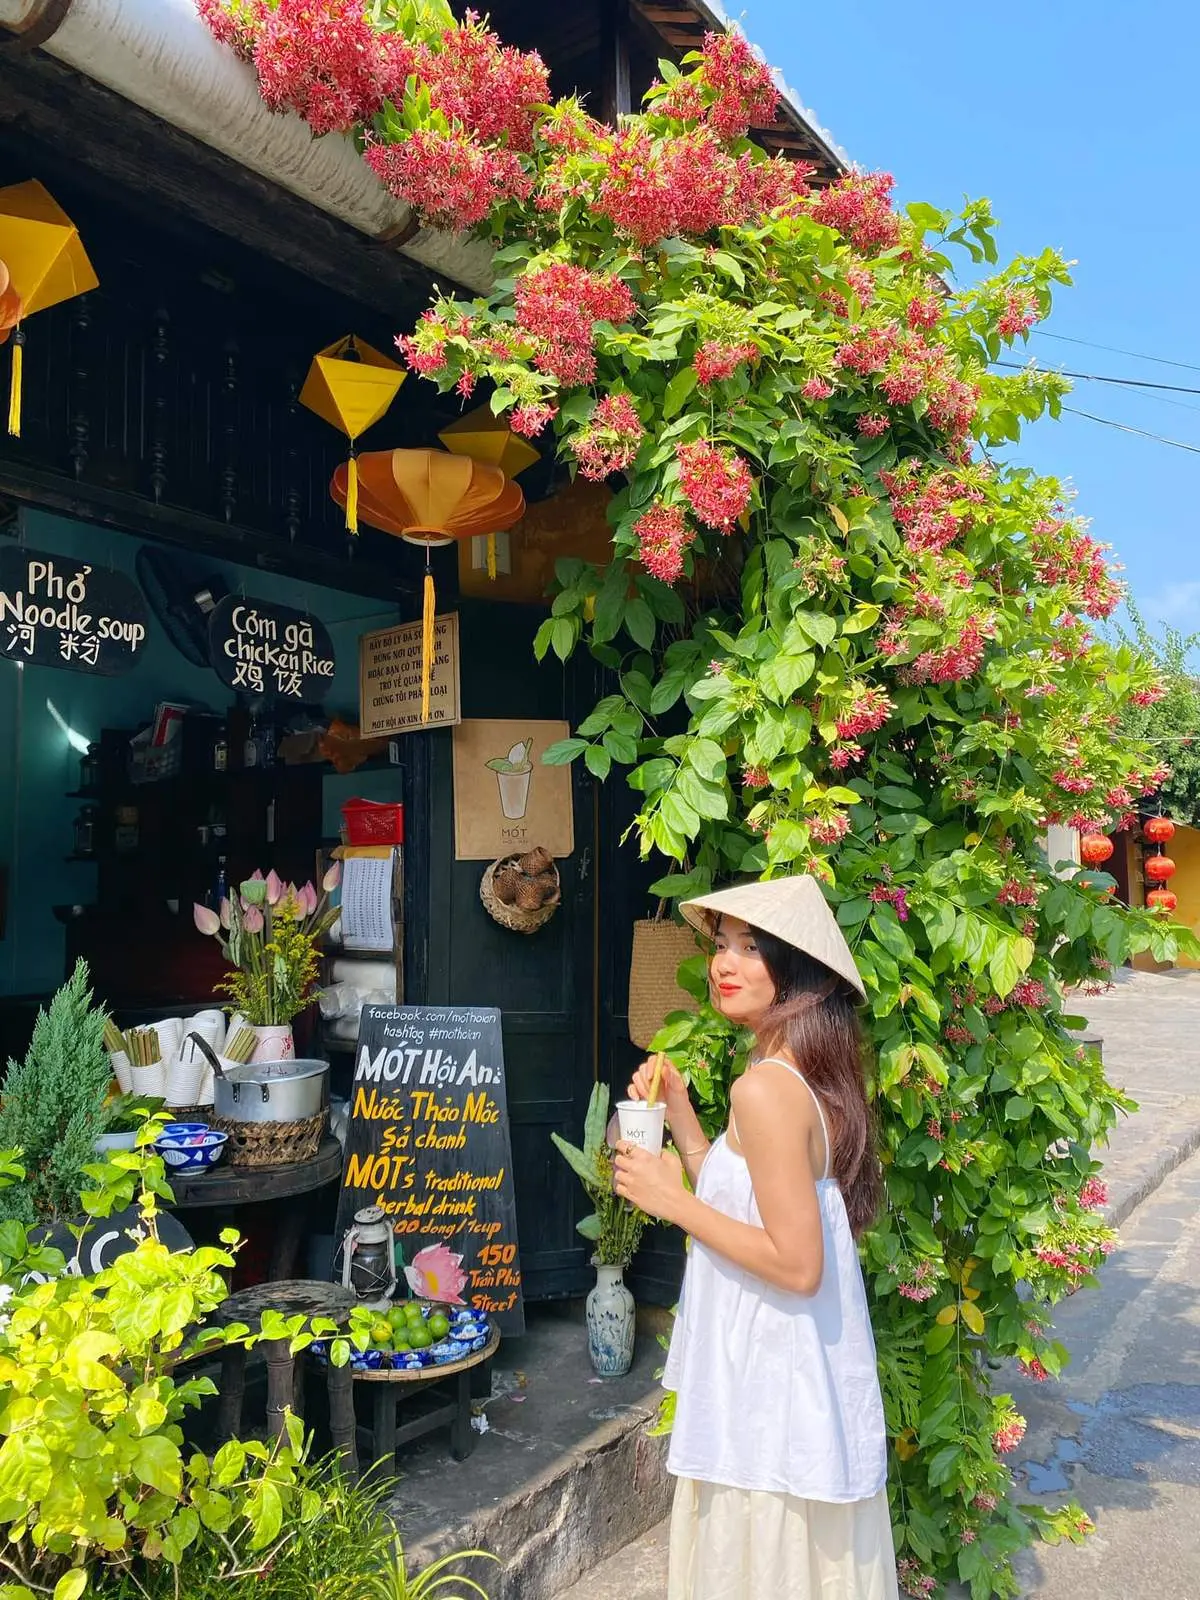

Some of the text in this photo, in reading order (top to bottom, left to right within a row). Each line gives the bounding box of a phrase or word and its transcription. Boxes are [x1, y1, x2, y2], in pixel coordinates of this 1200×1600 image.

[28, 561, 92, 603] Phở
[0, 591, 145, 653] Noodle soup
[283, 620, 313, 652] gà
[302, 650, 335, 677] Rice
[501, 824, 528, 838] MÓT
[383, 1022, 425, 1045] hashtag
[355, 1041, 423, 1085] MÓT
[419, 1049, 458, 1089] Hội
[410, 1090, 460, 1123] Thảo
[415, 1122, 469, 1150] chanh
[424, 1167, 505, 1192] traditional
[375, 1192, 478, 1217] herbal drink
[476, 1243, 518, 1267] 150
[470, 1290, 518, 1313] Street
